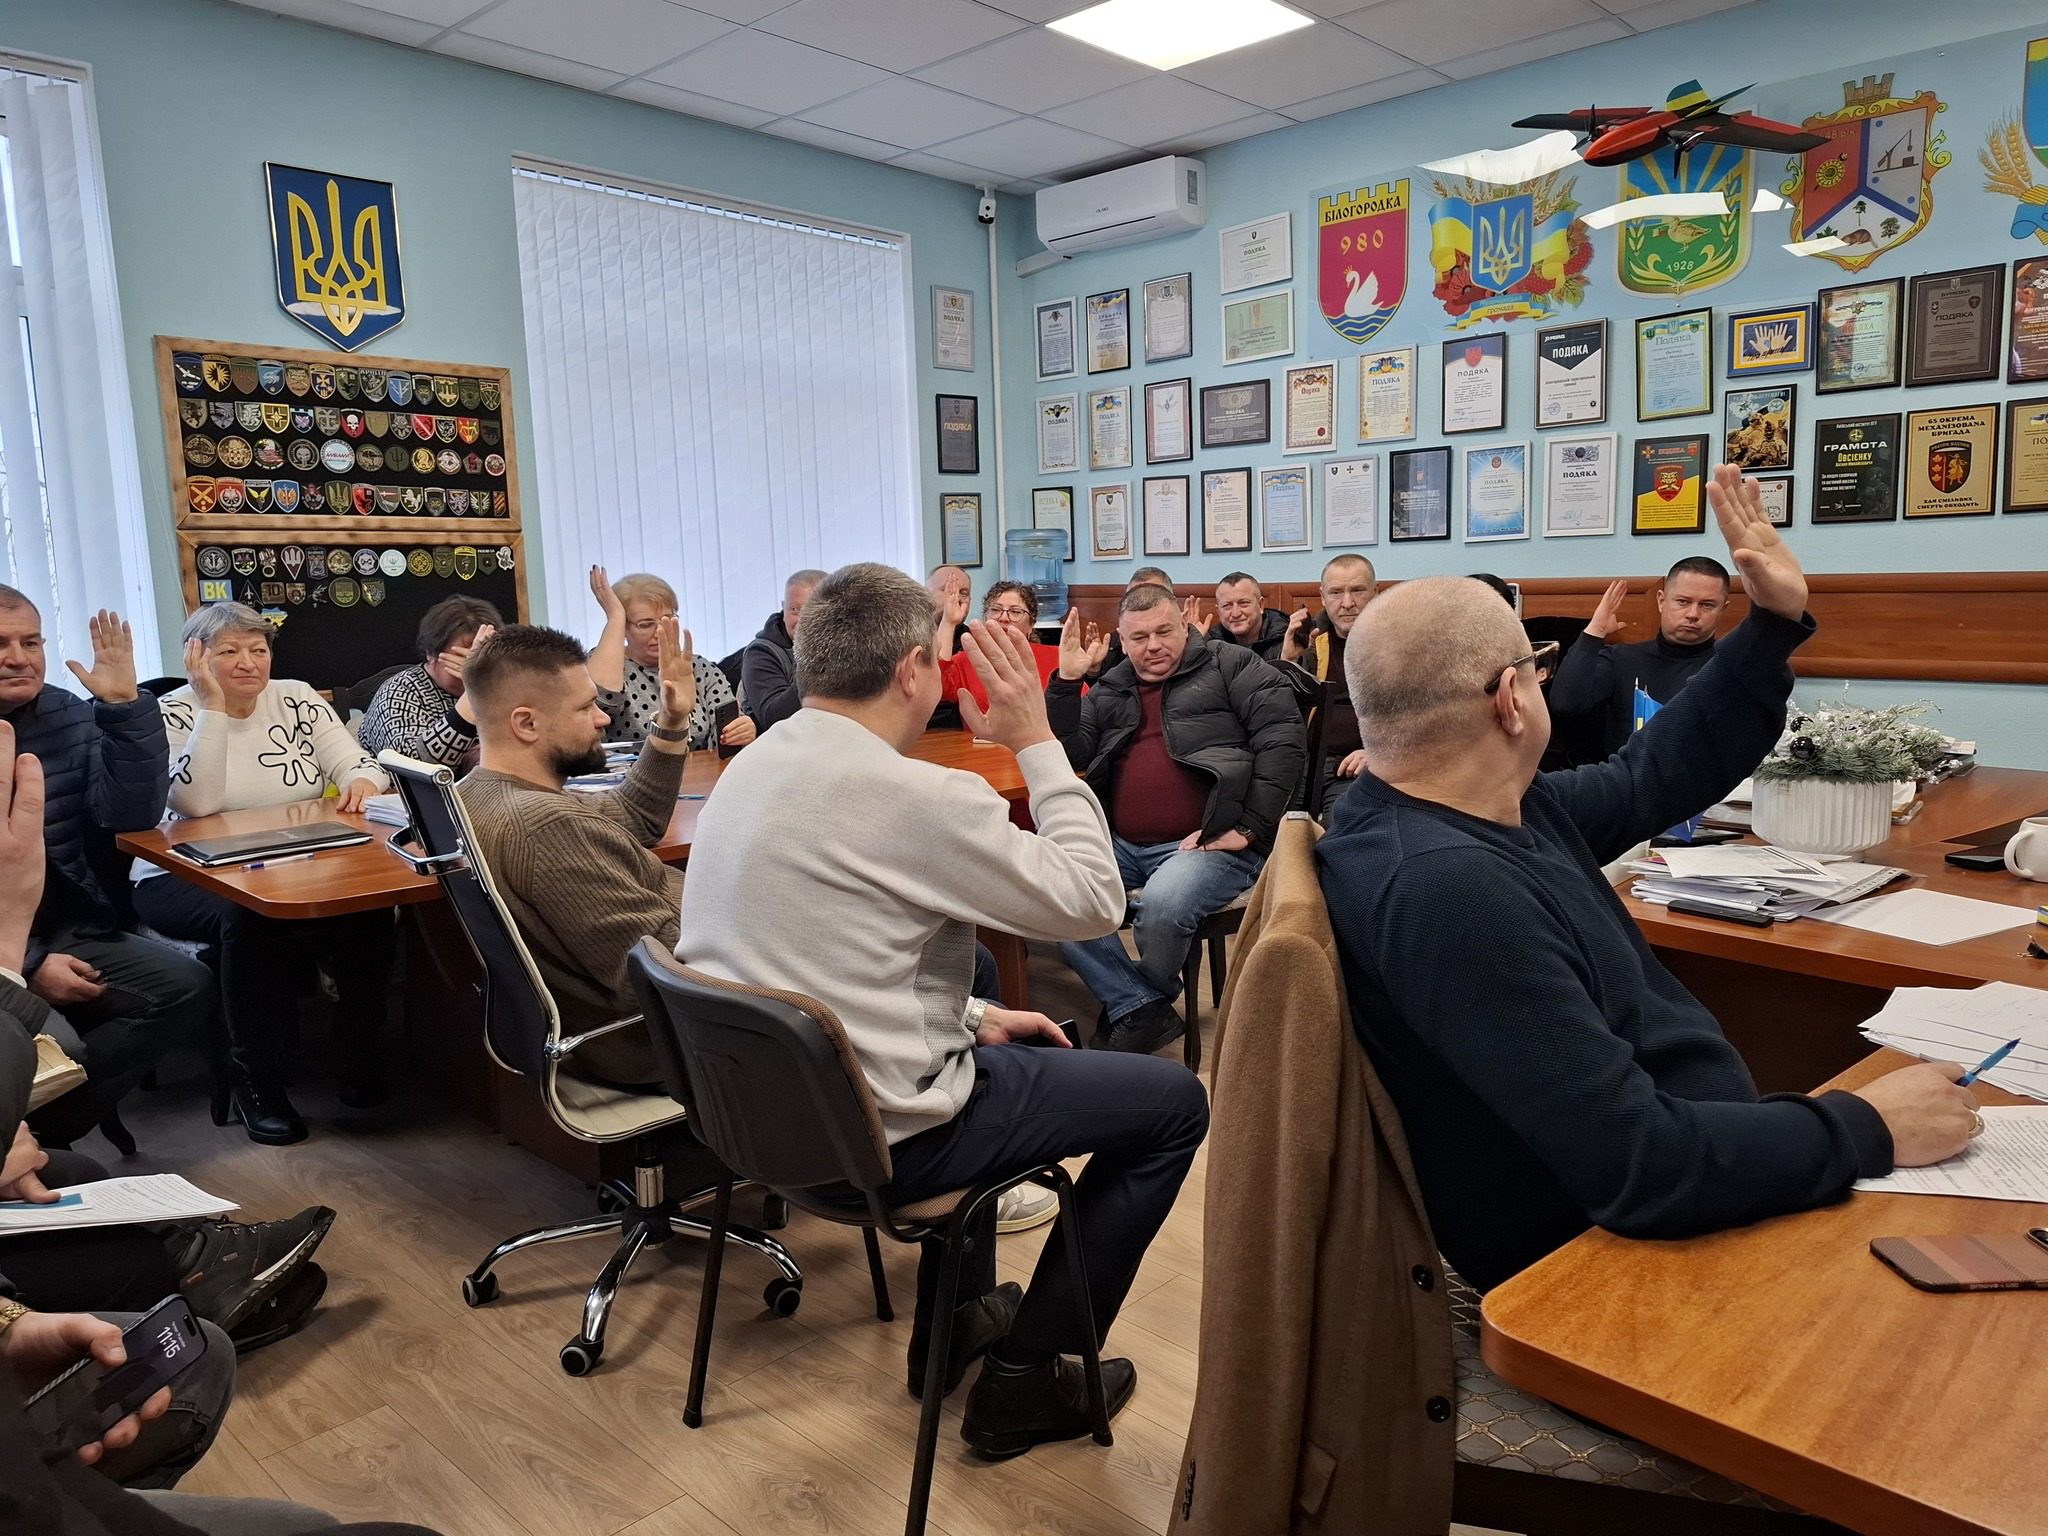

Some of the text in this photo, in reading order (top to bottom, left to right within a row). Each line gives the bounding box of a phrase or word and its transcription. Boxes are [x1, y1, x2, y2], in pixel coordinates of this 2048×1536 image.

[1324, 195, 1401, 223] БІЛОГОРОДКА
[1340, 229, 1384, 256] 980
[1666, 260, 1695, 273] 1928
[1935, 311, 1974, 321] ПОДЯКА
[1552, 344, 1589, 359] ПОДЯКА
[1457, 367, 1489, 377] ПОДЯКА
[1372, 376, 1401, 386] ПОДЯКА
[1939, 415, 1976, 423] ОКРЕМА
[943, 422, 972, 432] ПОДЯКА
[1917, 420, 1986, 431] МЕХАНІЗОВАНА
[1931, 428, 1971, 437] БРИГАДА
[1823, 441, 1888, 452] ГРАМОТА
[1562, 470, 1598, 479] ПОДЯКА
[1483, 477, 1509, 486] ПОДЯКА
[156, 1326, 181, 1358] 11:15
